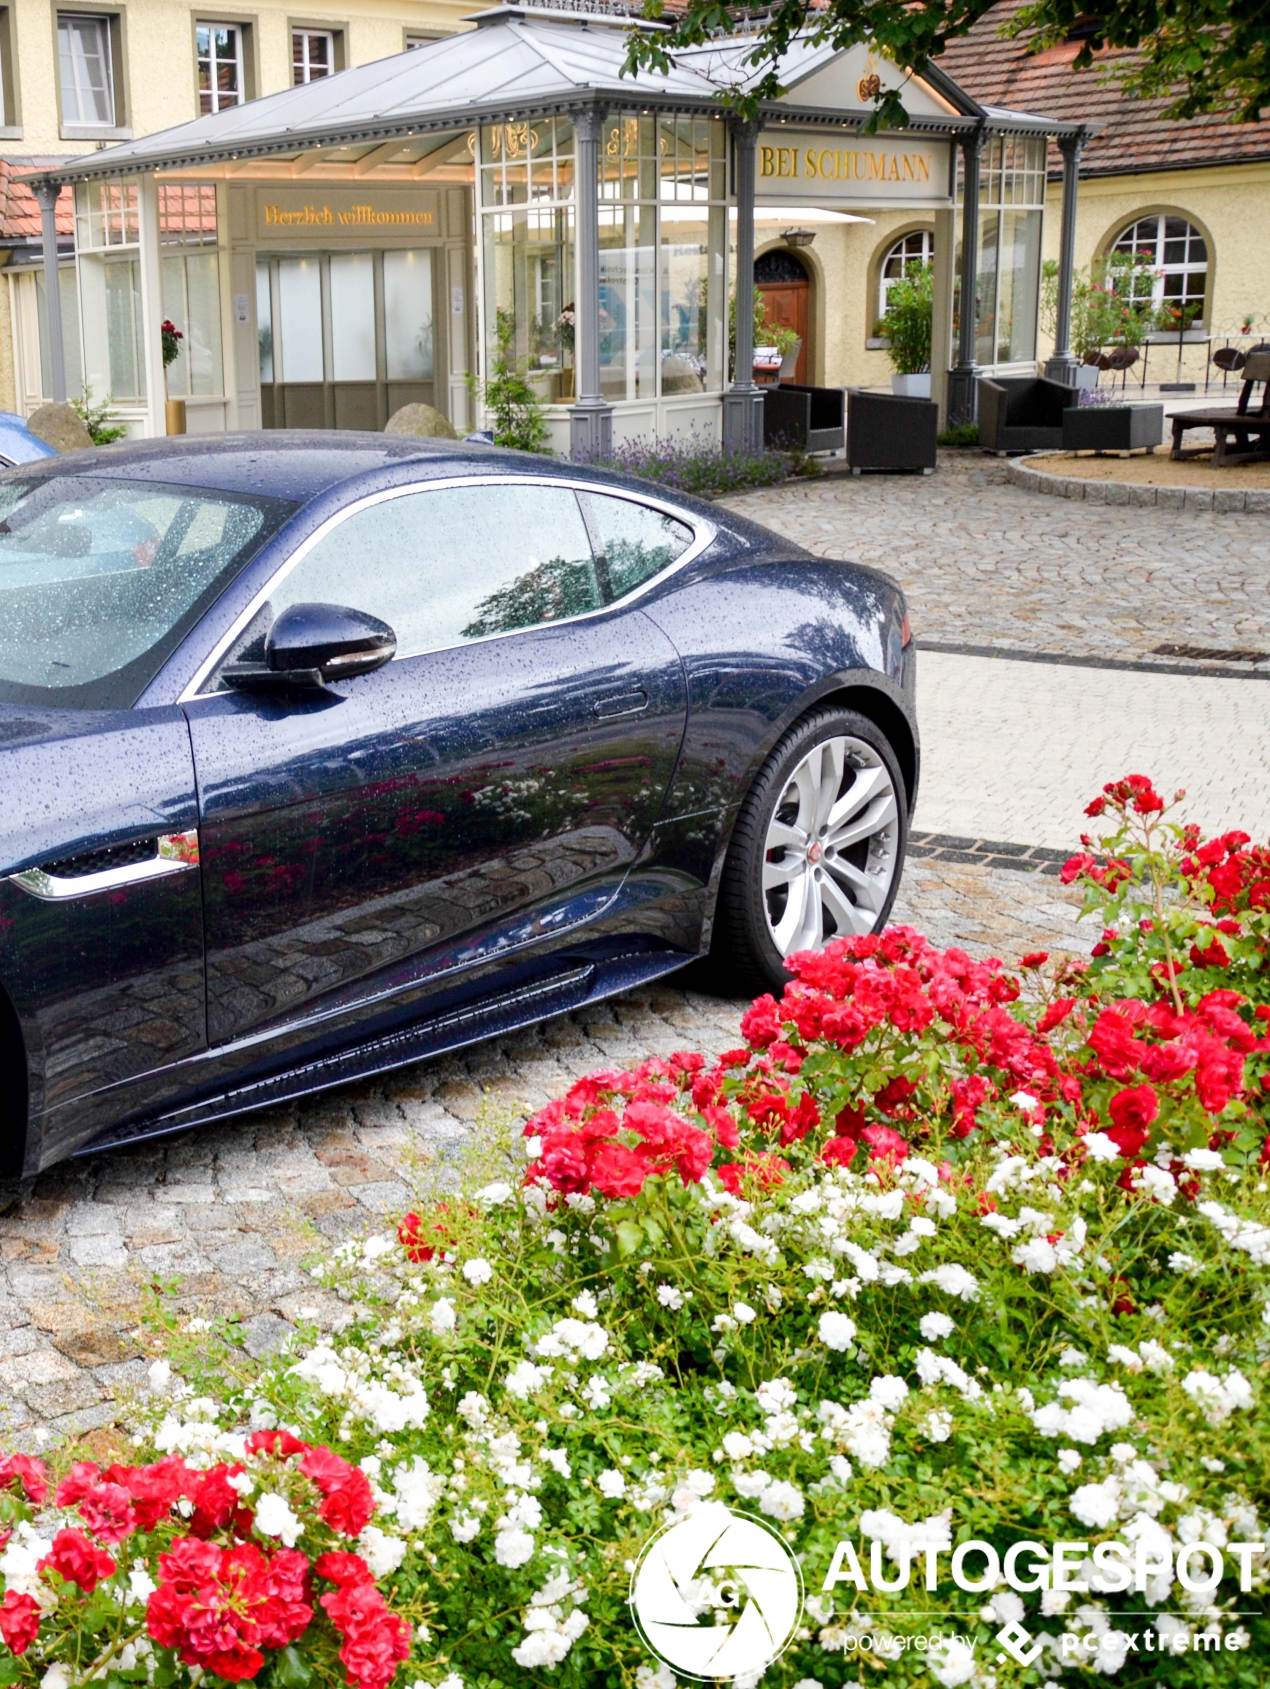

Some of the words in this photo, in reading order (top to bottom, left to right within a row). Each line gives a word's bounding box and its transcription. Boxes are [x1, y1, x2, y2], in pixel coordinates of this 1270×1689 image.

[760, 146, 798, 177] BEI
[804, 149, 931, 181] SCHUMANN
[265, 205, 334, 225] Herzlich
[338, 205, 433, 225] willkommen
